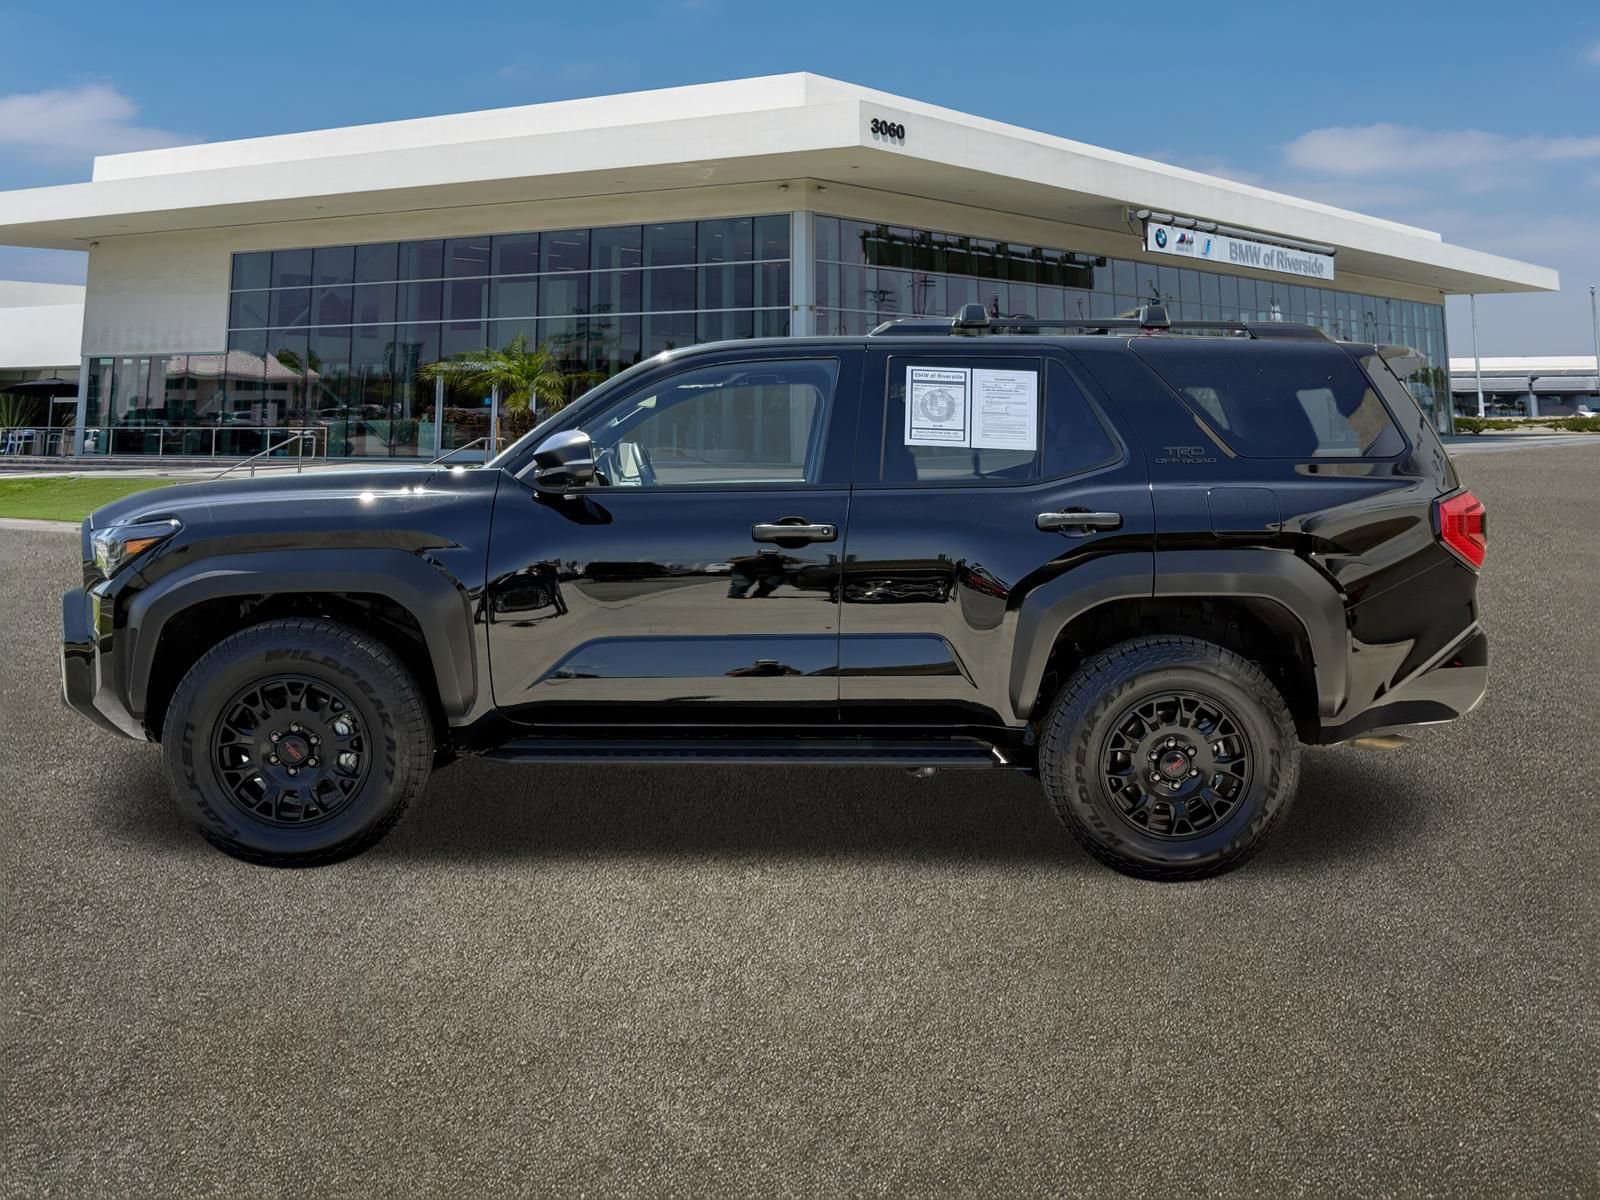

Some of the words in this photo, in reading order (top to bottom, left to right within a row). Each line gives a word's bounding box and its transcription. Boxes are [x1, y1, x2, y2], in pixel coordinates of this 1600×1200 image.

[871, 118, 905, 139] 3060
[1229, 241, 1261, 265] BMW
[1263, 252, 1275, 267] of
[1277, 252, 1325, 275] Riverside
[1163, 446, 1205, 458] TRD
[264, 648, 395, 727] WILDPEAK
[1072, 706, 1126, 847] WILDPEAK
